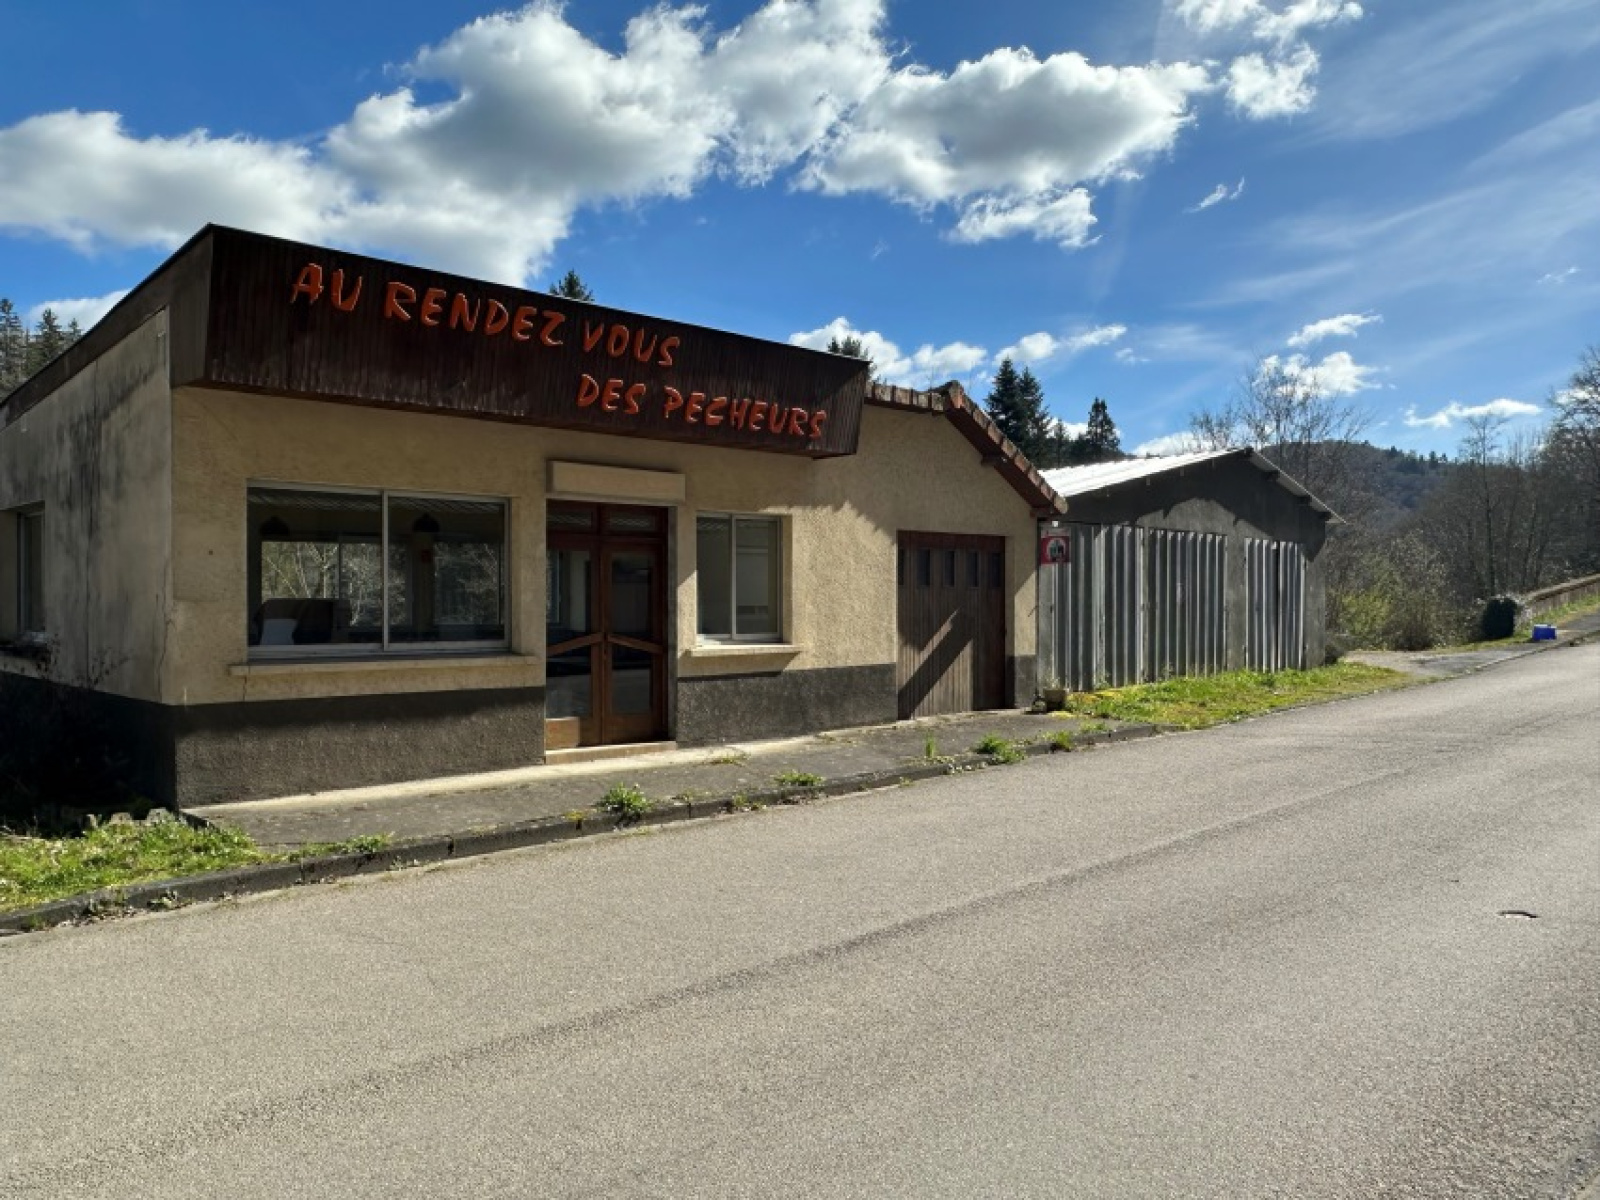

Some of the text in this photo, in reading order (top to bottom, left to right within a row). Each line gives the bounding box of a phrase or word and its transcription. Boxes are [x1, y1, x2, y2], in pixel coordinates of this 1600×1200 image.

[290, 263, 680, 367] AU RENDEZ VOUS
[577, 373, 827, 439] DES PECHEURS
